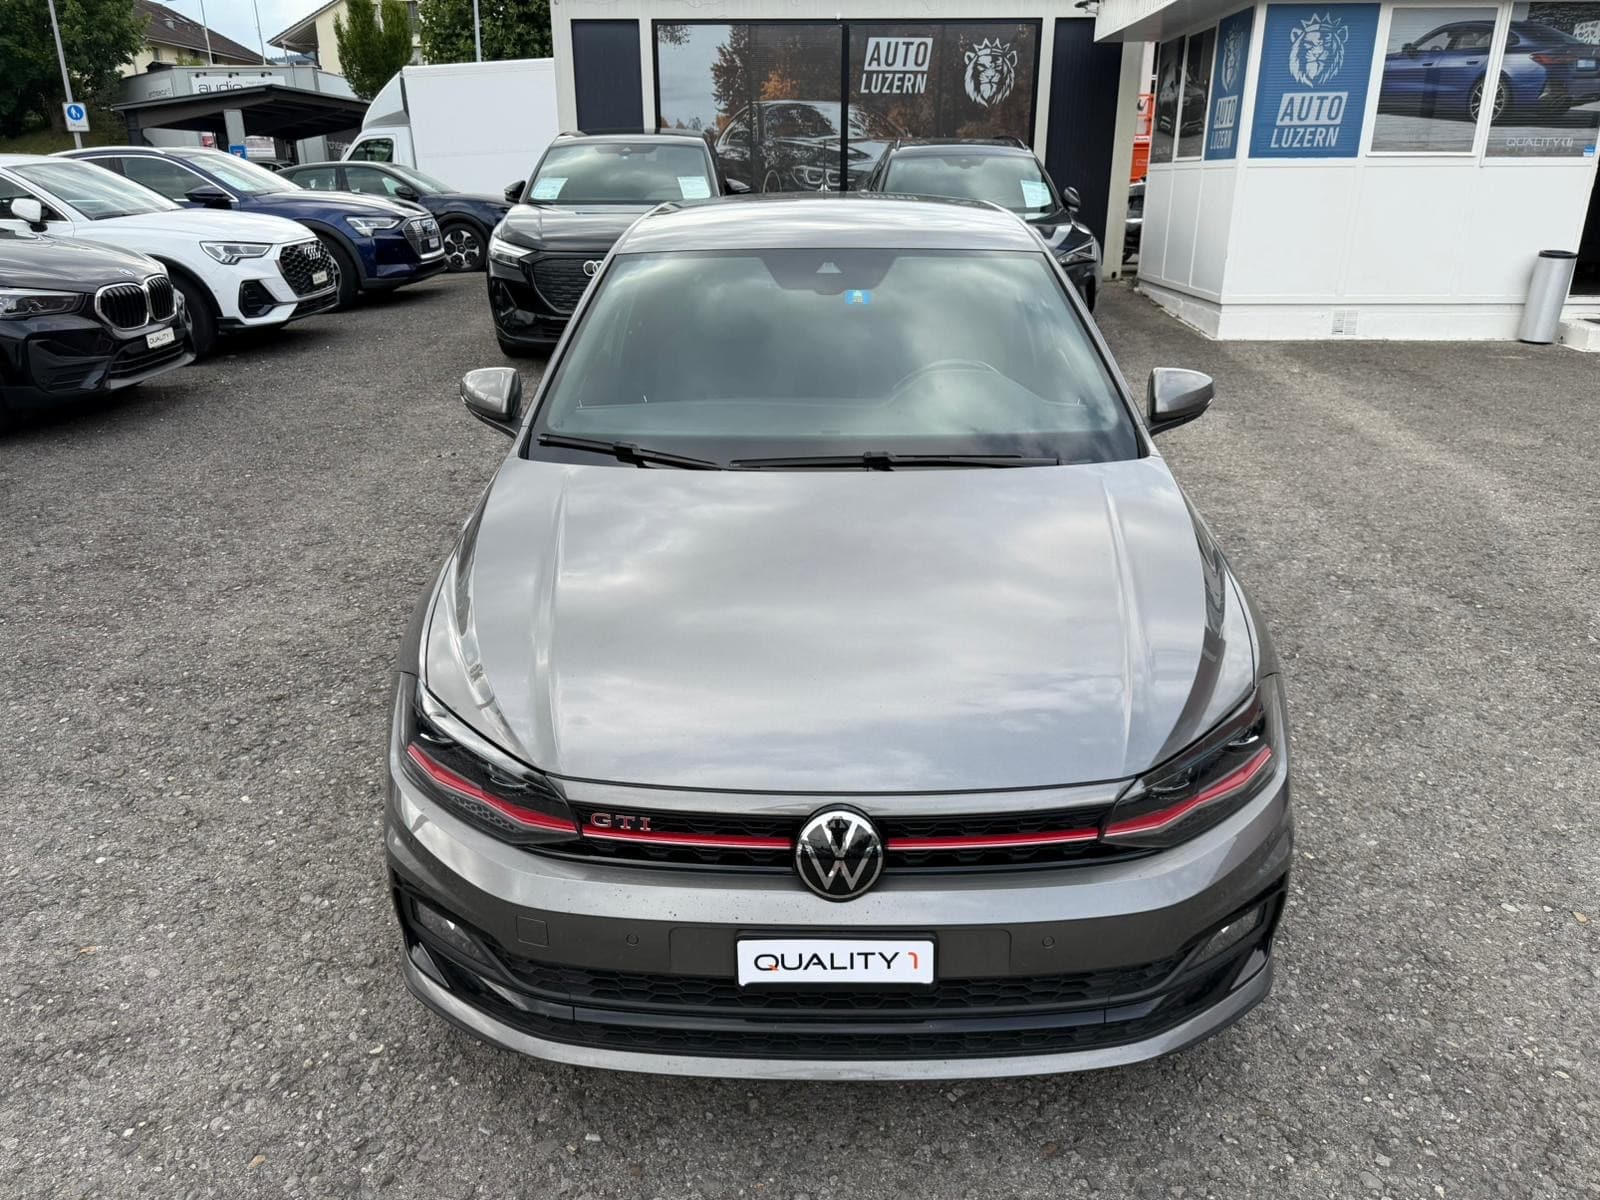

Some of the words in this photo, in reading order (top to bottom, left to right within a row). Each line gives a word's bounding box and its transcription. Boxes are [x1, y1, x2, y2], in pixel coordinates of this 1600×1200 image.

[867, 41, 929, 68] AUTO
[860, 72, 928, 94] LUZERN
[1216, 98, 1237, 126] AUTO
[1280, 95, 1343, 122] AUTO
[1210, 130, 1233, 150] LUZERN
[1270, 127, 1340, 148] LUZERN
[590, 812, 651, 832] GTI
[753, 951, 900, 972] QUALITY
